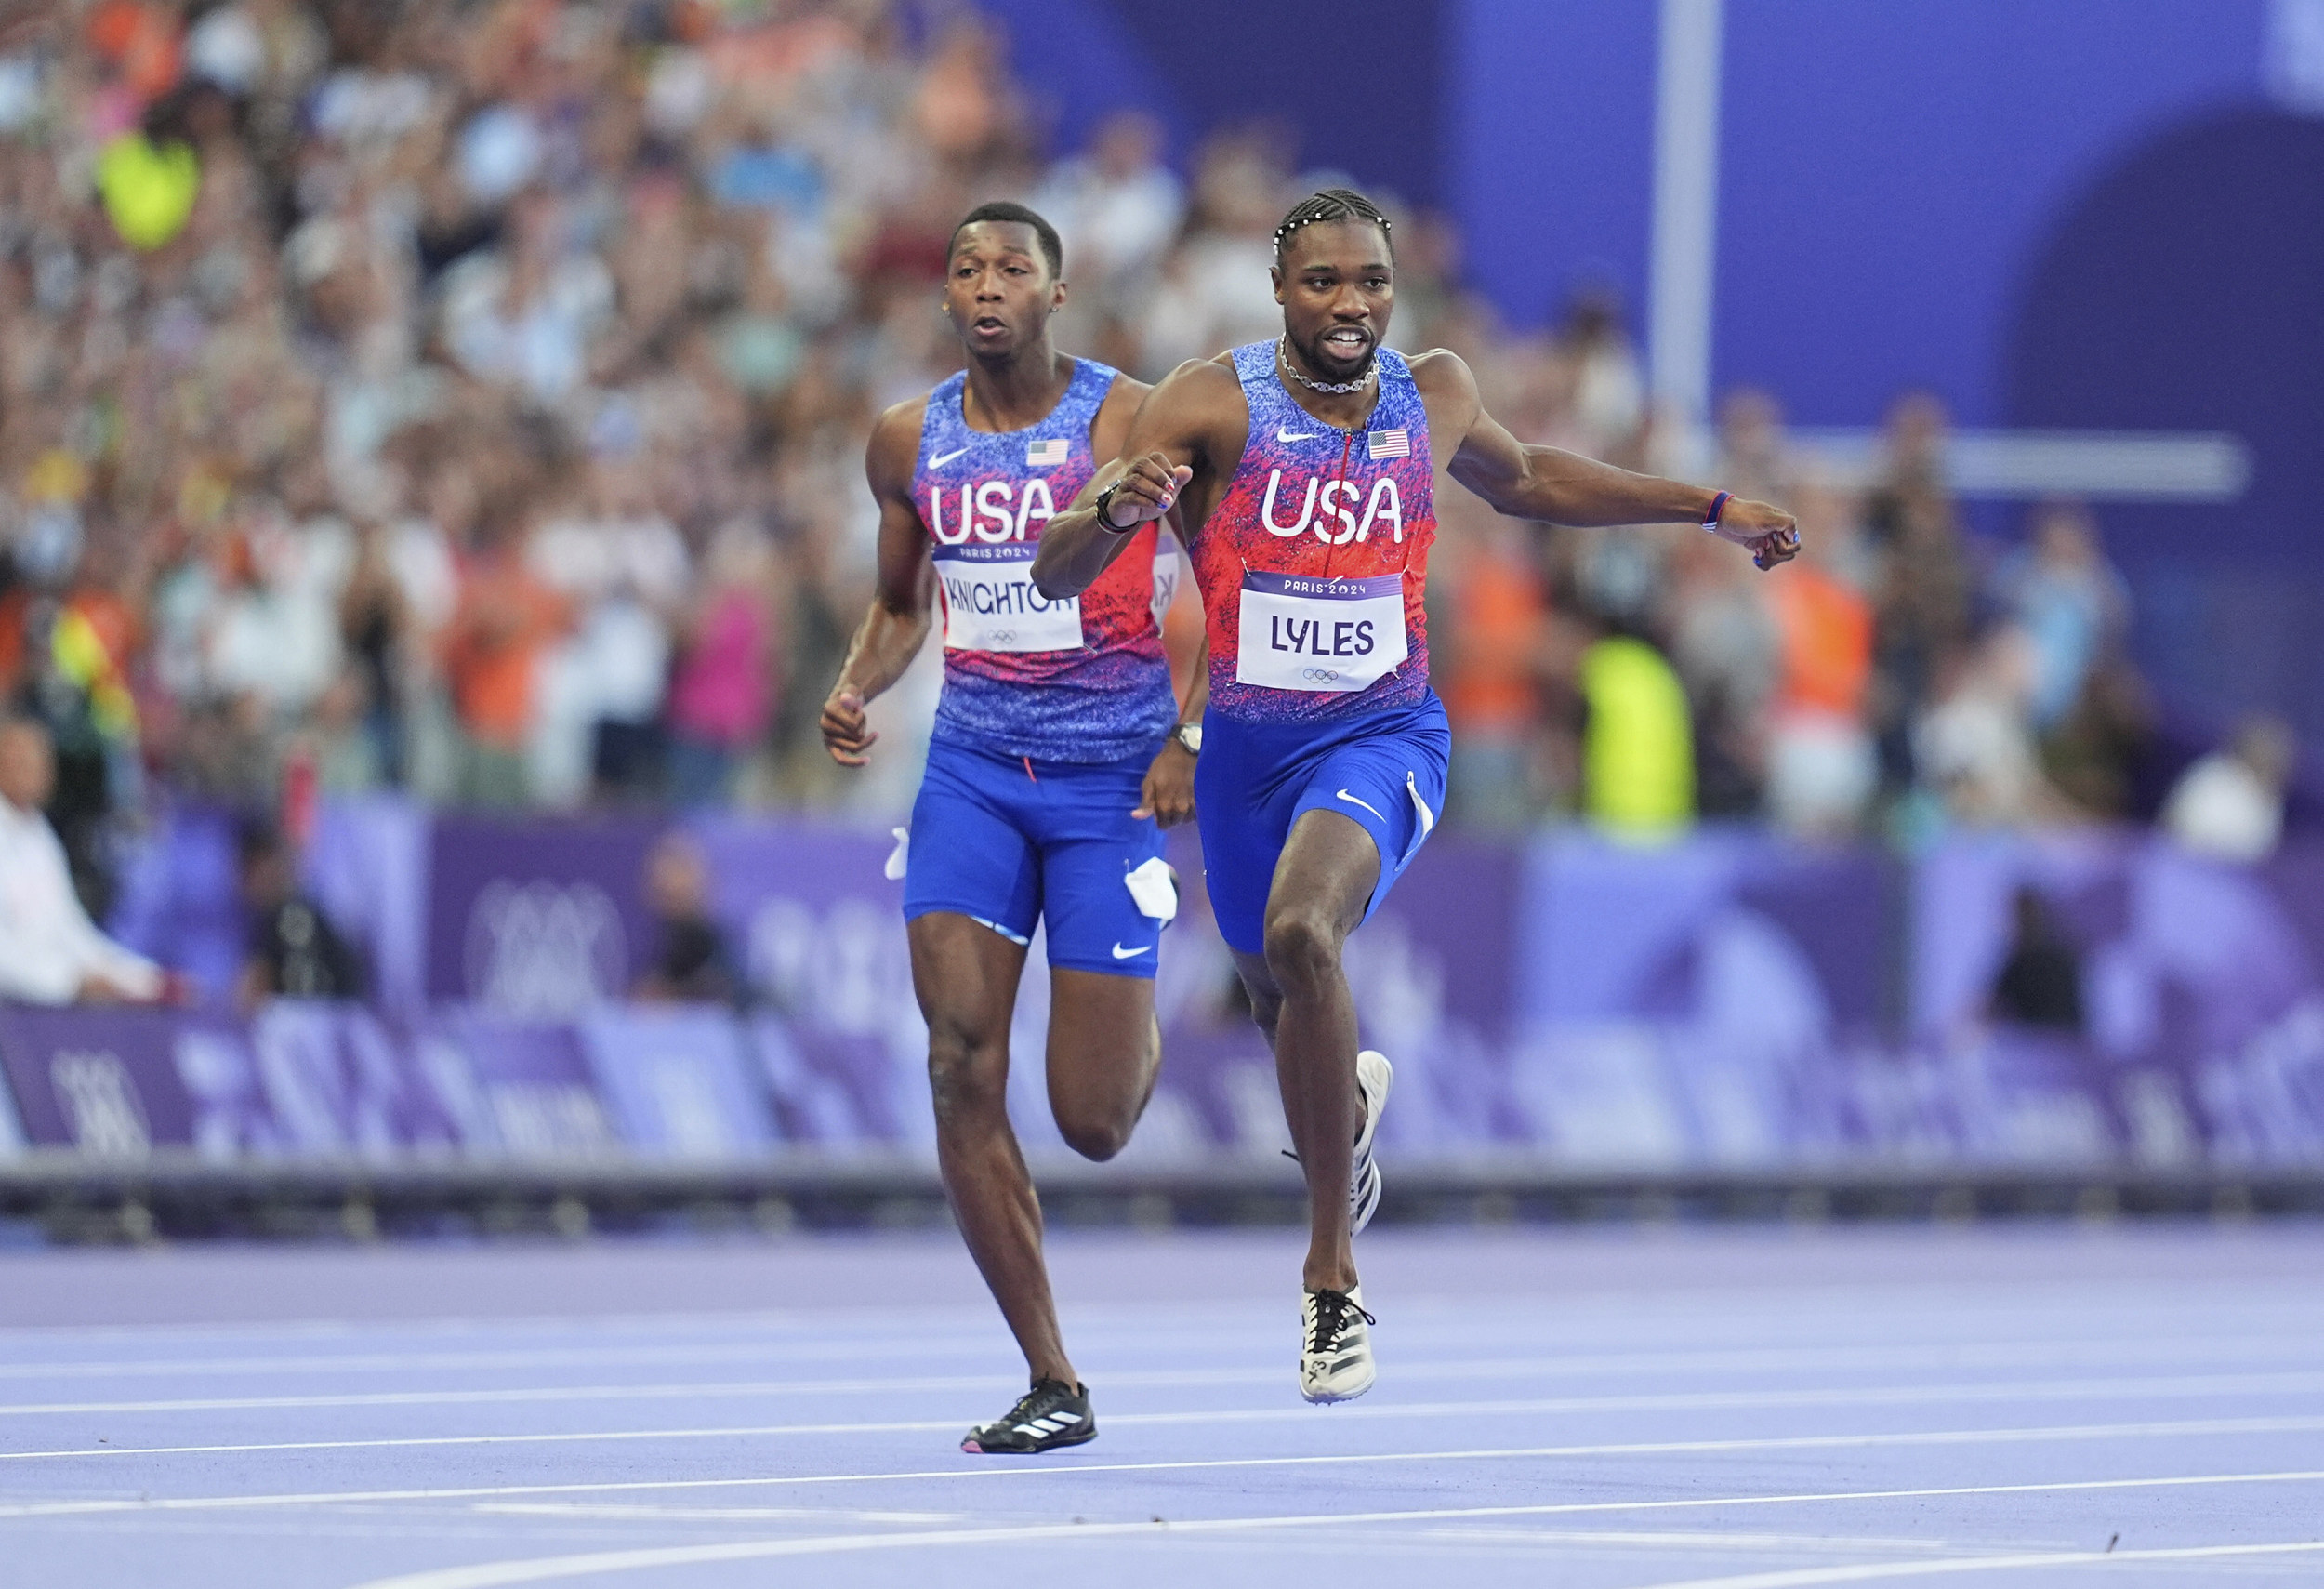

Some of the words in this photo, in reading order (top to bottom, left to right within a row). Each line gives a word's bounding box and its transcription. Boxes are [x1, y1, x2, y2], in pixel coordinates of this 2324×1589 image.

[931, 478, 1056, 545] USA
[1261, 468, 1403, 545] USA
[959, 547, 992, 559] PARIS
[995, 547, 1031, 558] 2024
[1284, 579, 1324, 593] PARIS
[1328, 584, 1366, 595] 2024
[1271, 615, 1374, 656] LYLES
